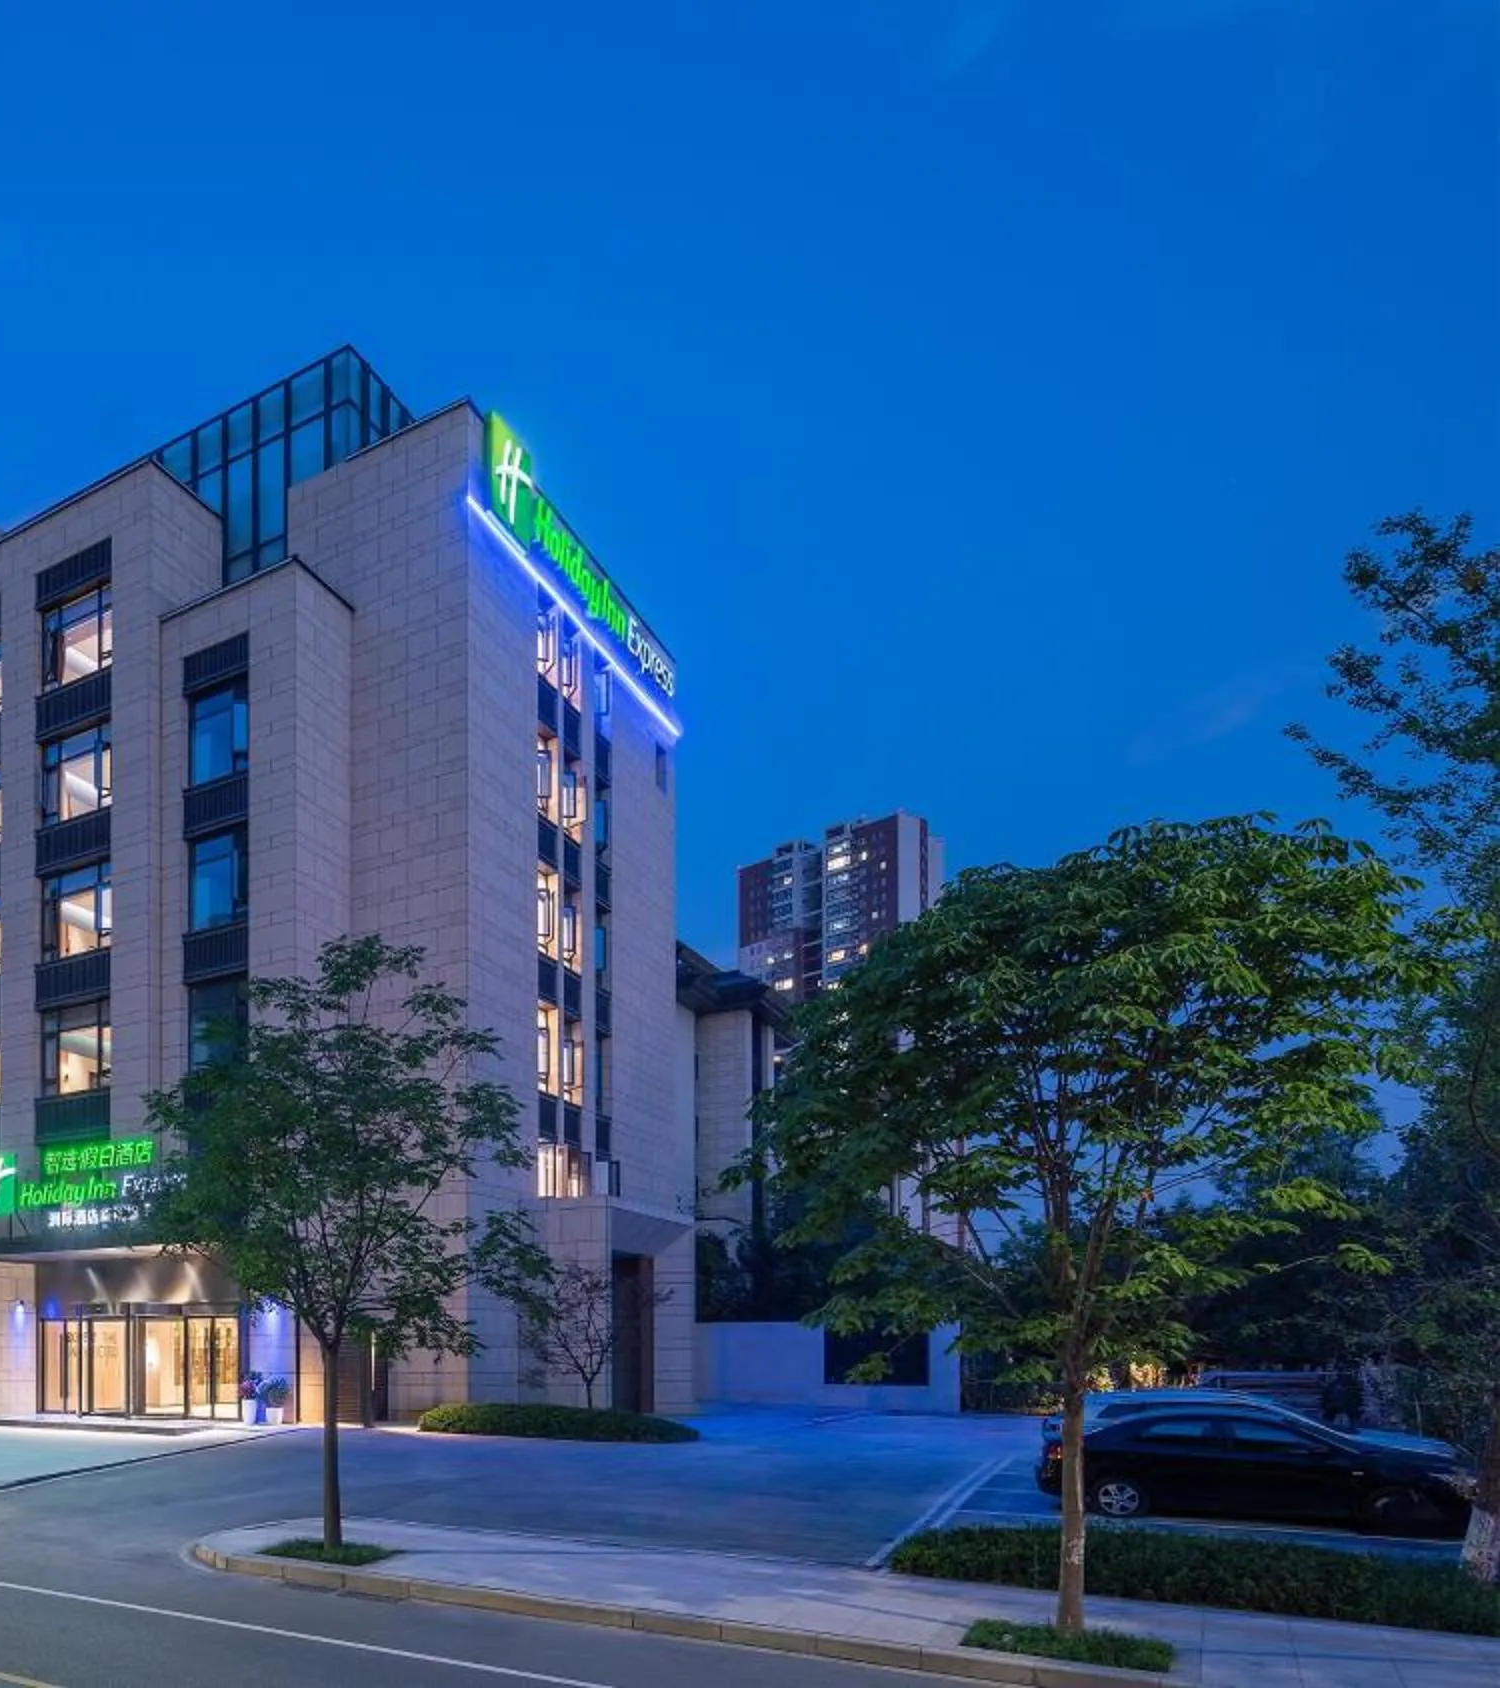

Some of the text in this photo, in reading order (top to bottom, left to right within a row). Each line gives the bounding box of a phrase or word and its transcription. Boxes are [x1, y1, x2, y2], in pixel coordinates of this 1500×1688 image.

[534, 497, 675, 698] Holiday Inn Express
[19, 1180, 86, 1208] Holiday
[87, 1175, 117, 1200] Inn
